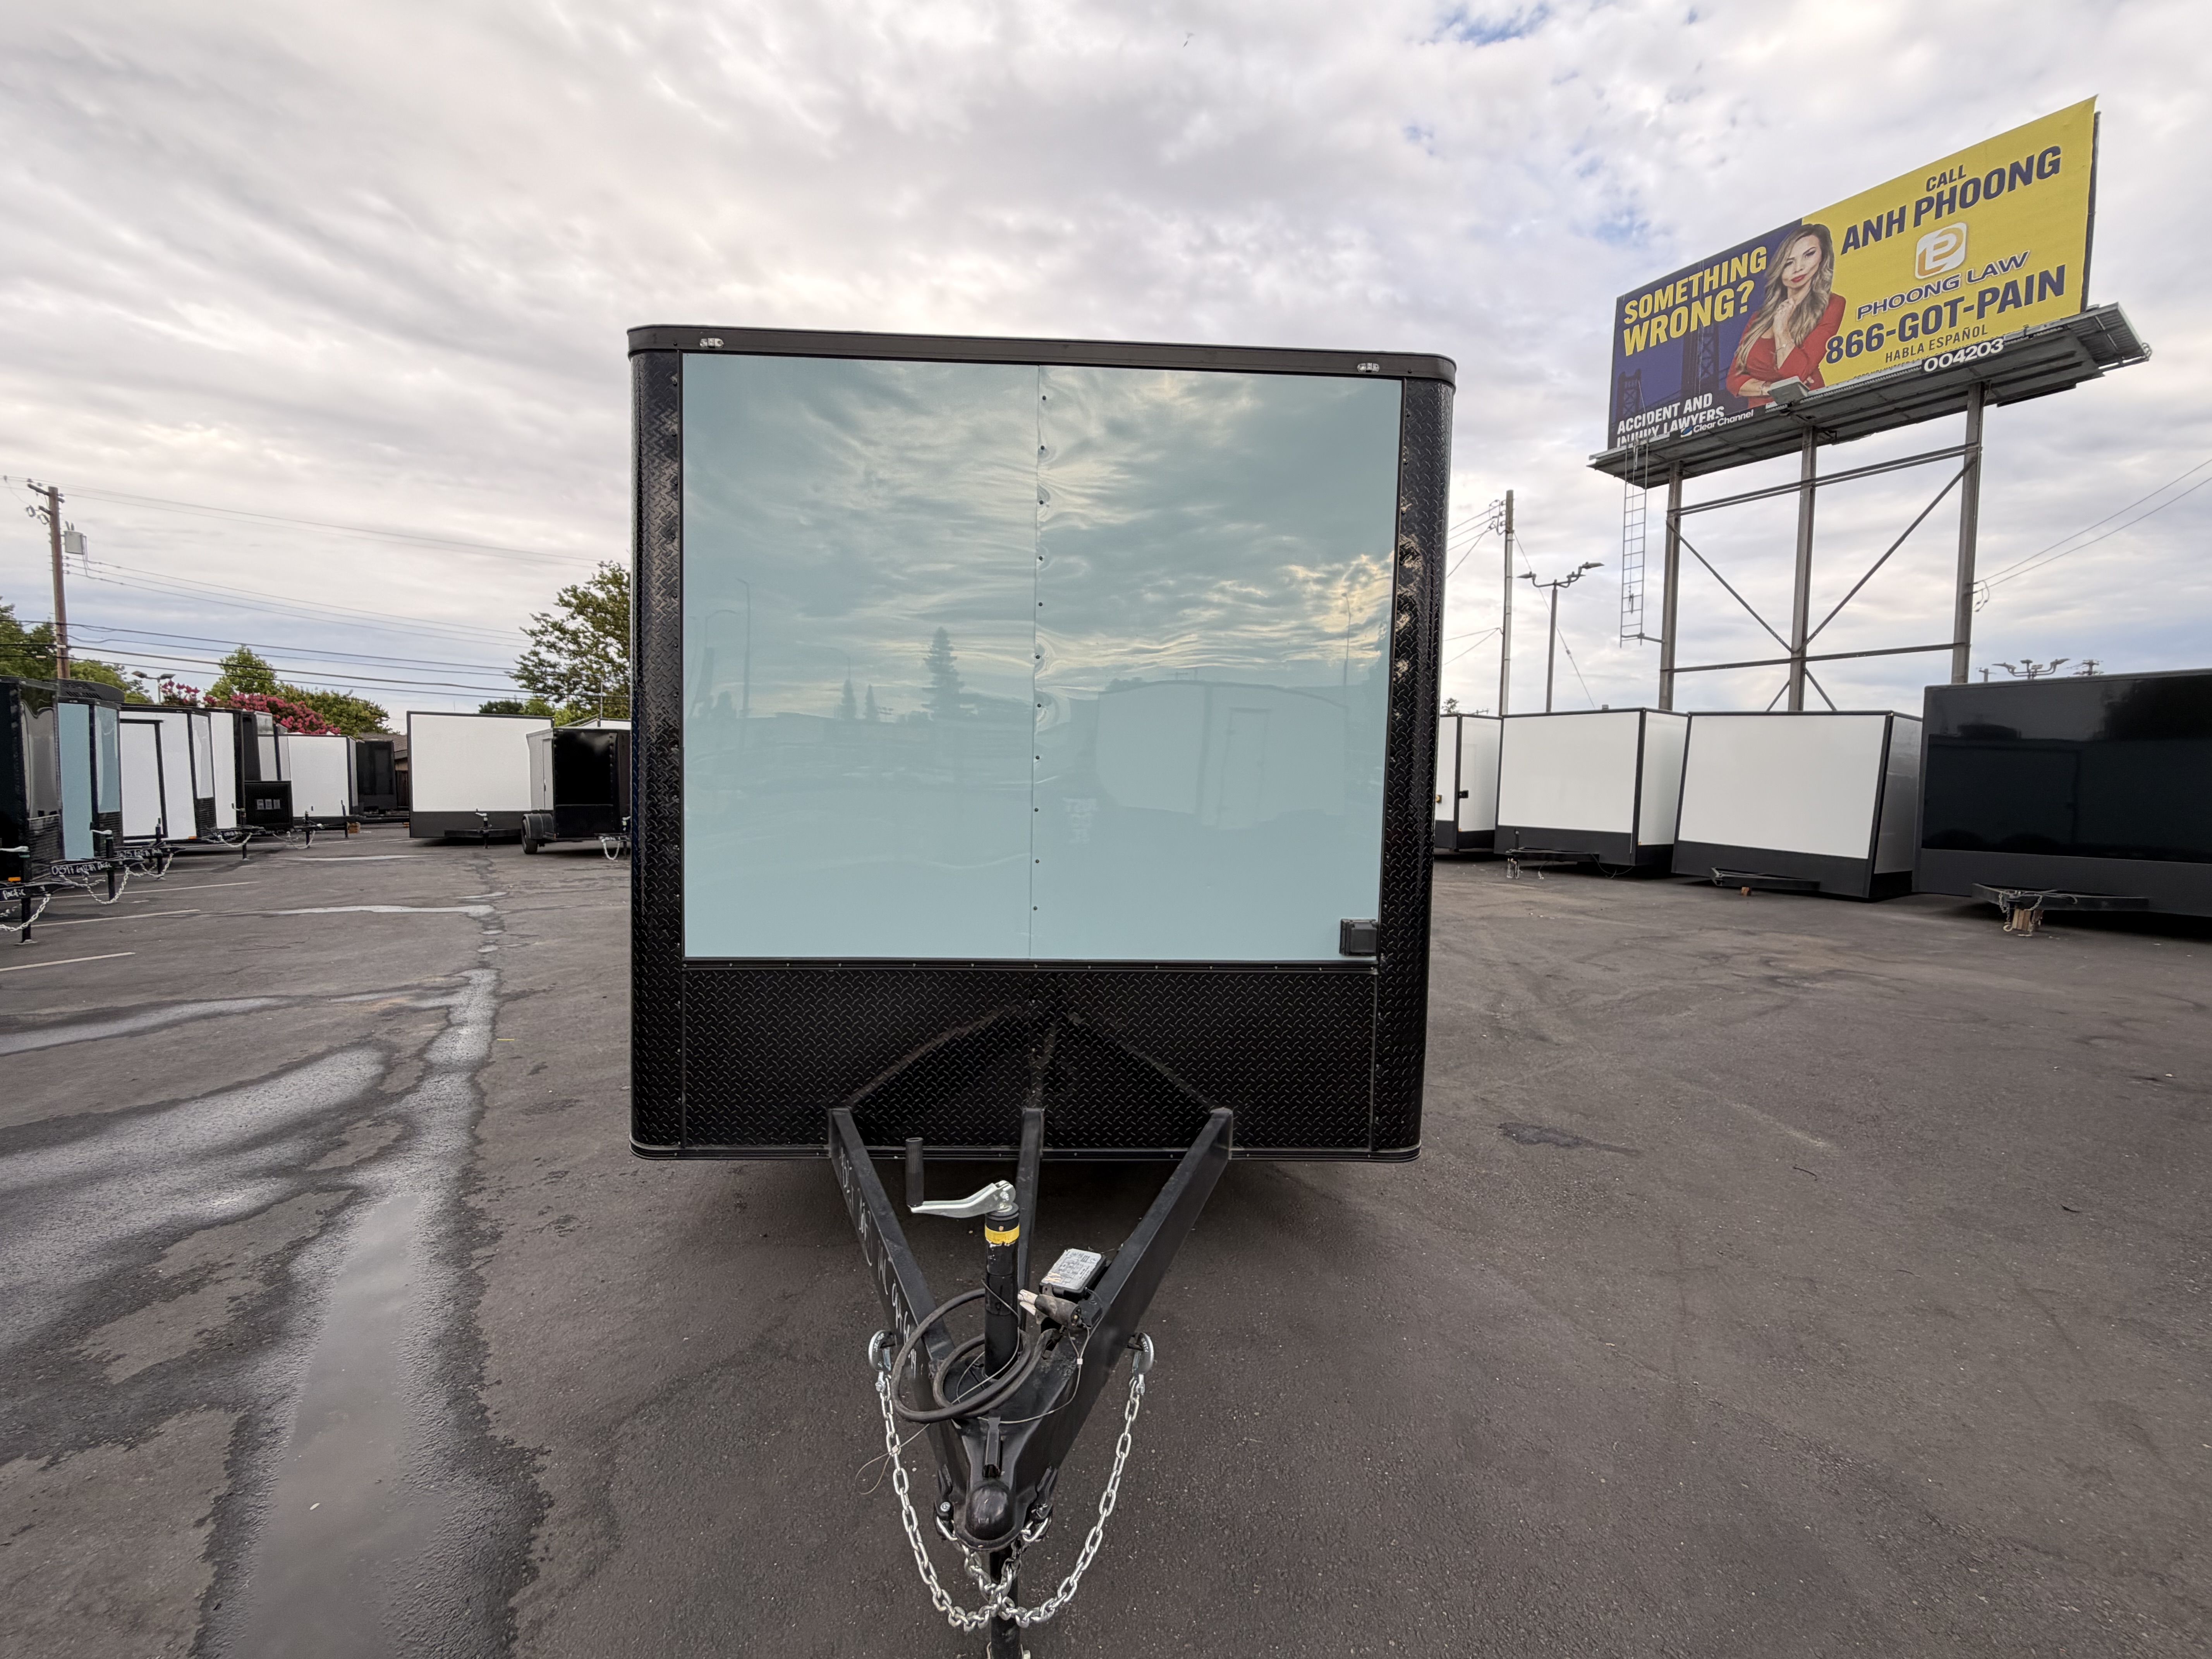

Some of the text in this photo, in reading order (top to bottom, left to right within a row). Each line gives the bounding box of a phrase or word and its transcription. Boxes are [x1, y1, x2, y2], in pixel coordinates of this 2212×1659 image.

[1840, 146, 2061, 256] ANH PHOONG
[1926, 164, 1966, 192] CALL
[1624, 246, 1767, 324] SOMETHING
[1857, 250, 2030, 321] PHOONG LAW
[1623, 280, 1755, 357] WRONG?
[1826, 264, 2066, 364] 866-GOT-PAIN
[1886, 324, 1988, 363] HABLA ESPAÑOL
[1923, 338, 2004, 372] 004203
[1617, 393, 1713, 435] ACCIDENT AND
[1693, 409, 1754, 433] Clear Channel
